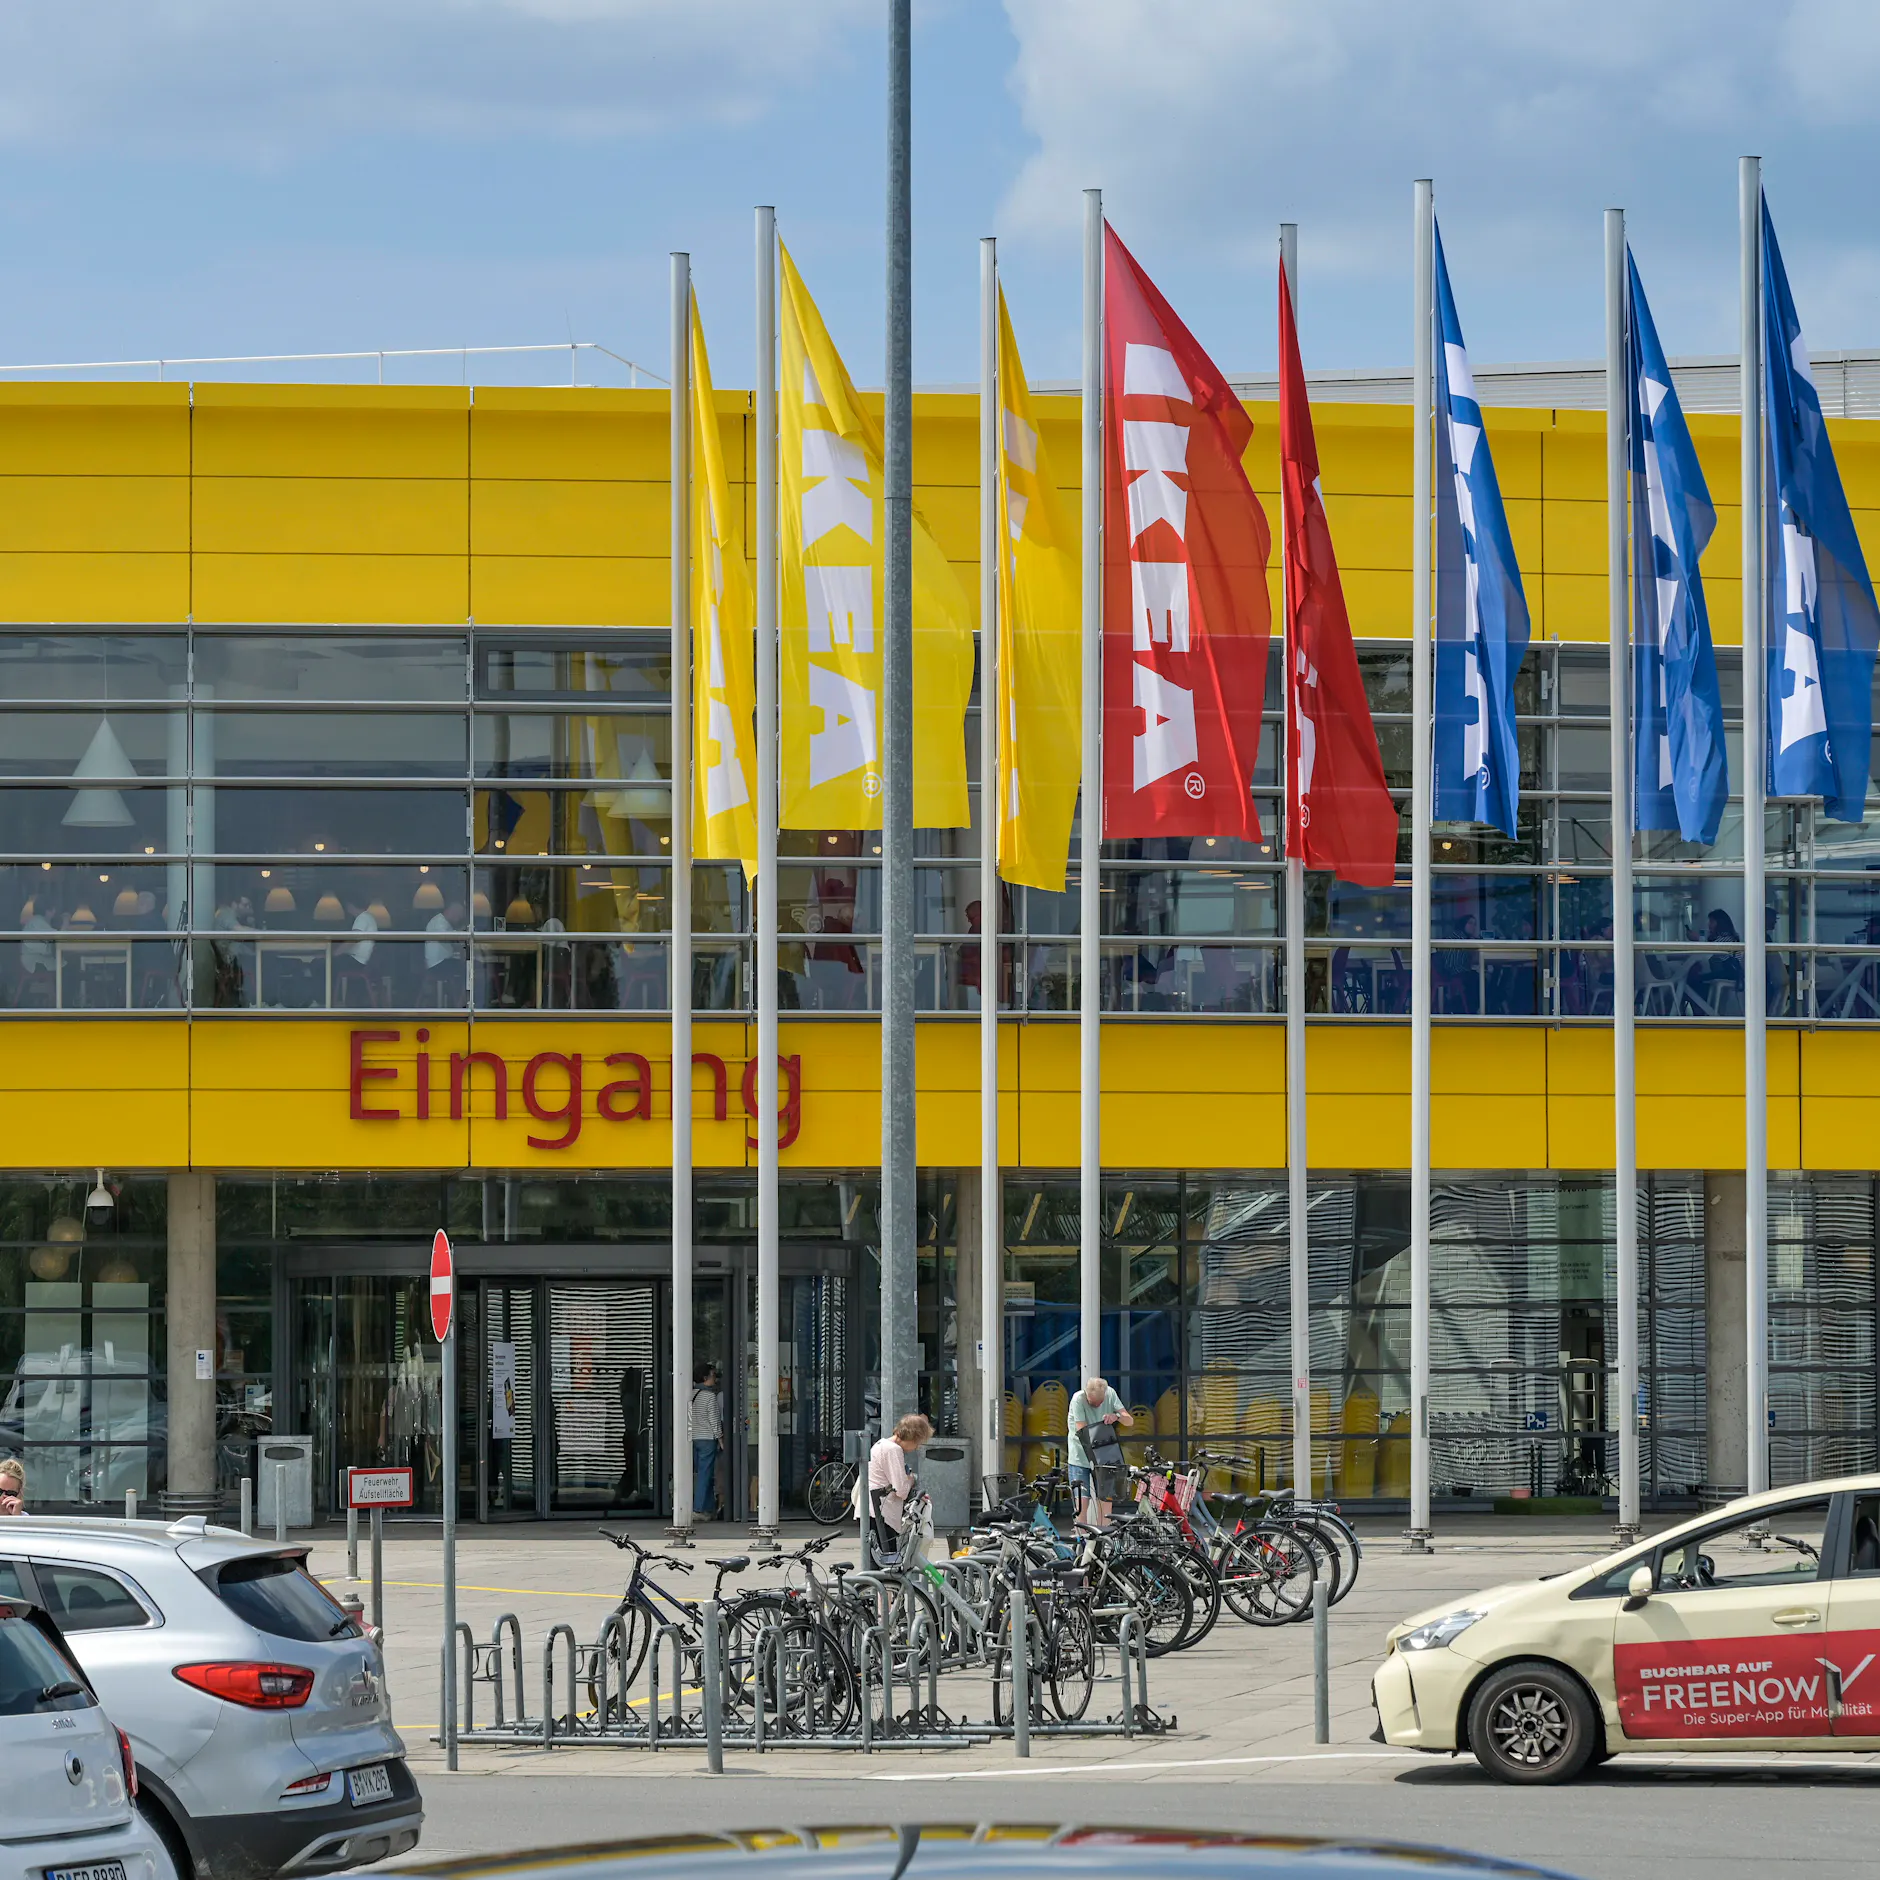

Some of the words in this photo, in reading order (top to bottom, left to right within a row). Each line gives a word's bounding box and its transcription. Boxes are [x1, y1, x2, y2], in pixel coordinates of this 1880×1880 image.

[1124, 342, 1199, 793] IKEA
[350, 1028, 801, 1149] Eingang
[364, 1477, 399, 1486] Feuerwehr
[359, 1488, 404, 1499] Aufstellfläche
[1640, 1664, 1731, 1679] BUCHBAR
[1736, 1661, 1773, 1673] AUF
[1642, 1675, 1820, 1711] FREENOW
[1684, 1713, 1706, 1725] Die
[1710, 1709, 1784, 1726] Super-App
[1788, 1707, 1806, 1719] für
[1811, 1703, 1873, 1718] Moilität
